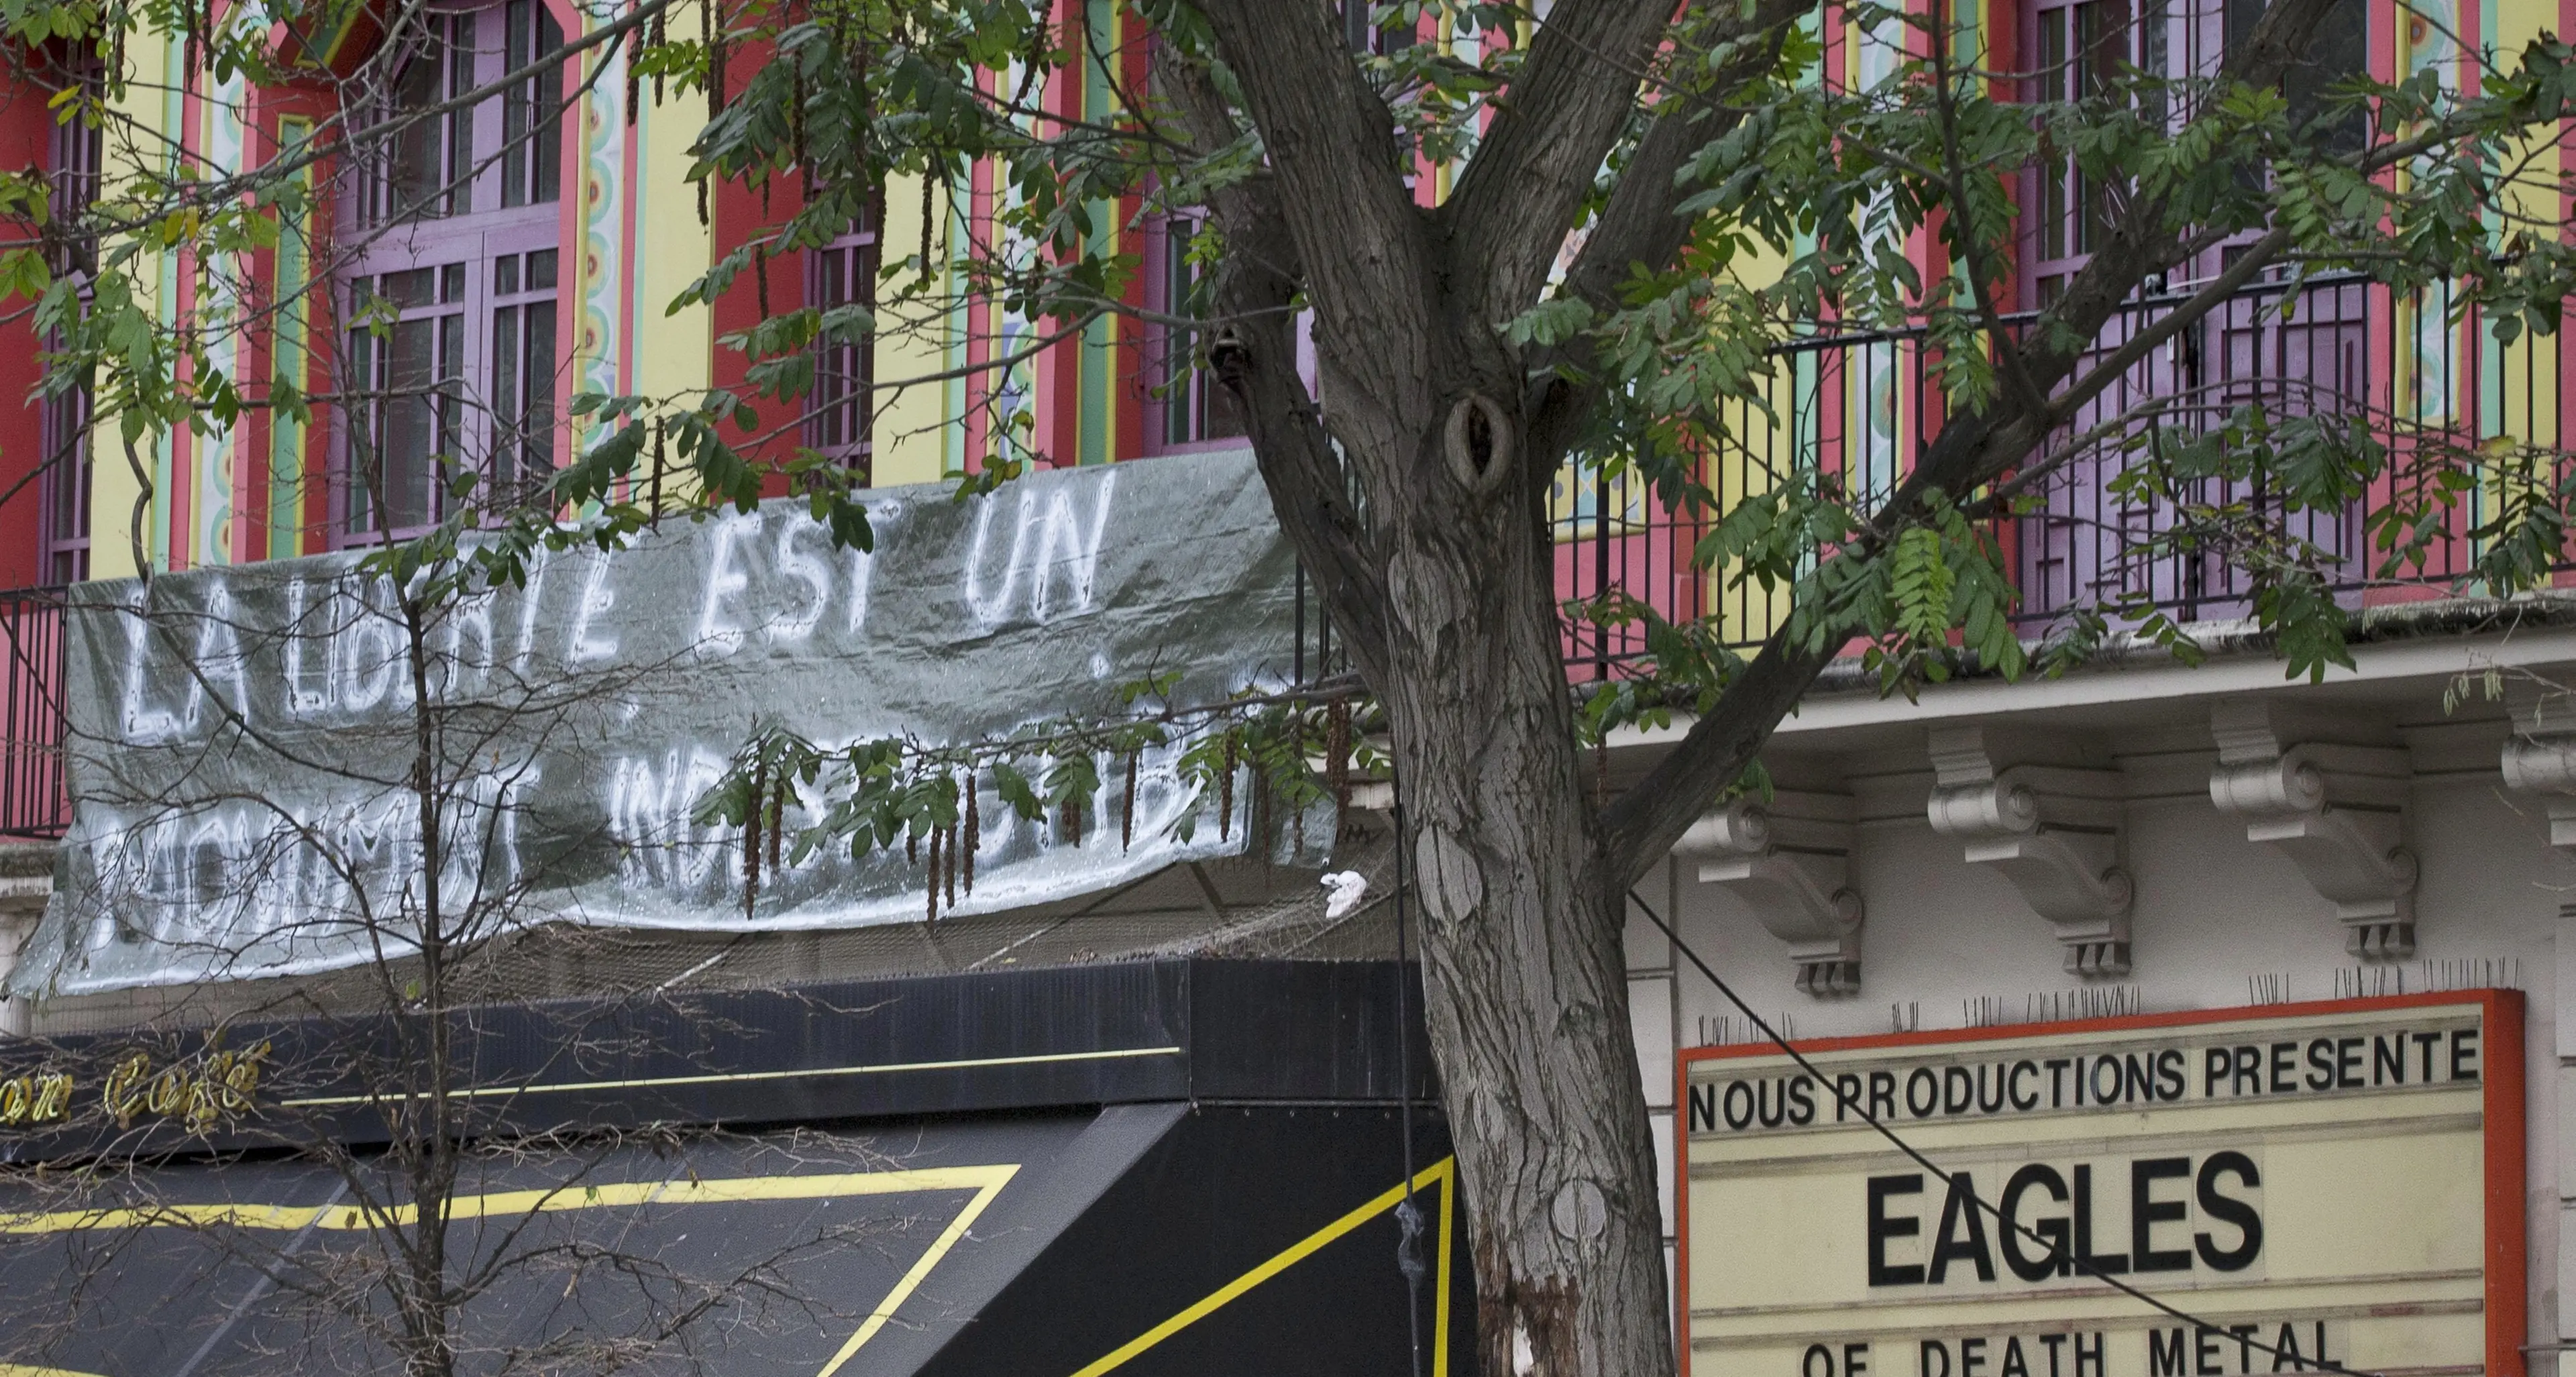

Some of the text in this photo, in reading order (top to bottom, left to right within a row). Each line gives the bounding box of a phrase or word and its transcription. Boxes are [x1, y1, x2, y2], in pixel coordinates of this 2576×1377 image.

[121, 578, 250, 739] LA
[694, 498, 903, 654] EST
[964, 470, 1116, 629] UN
[1688, 1029, 2479, 1132] NOUS PRODUCTIONS PRESENTE
[1867, 1150, 2263, 1288] EAGLES
[1803, 1320, 2343, 1377] OF DEATH METAL
